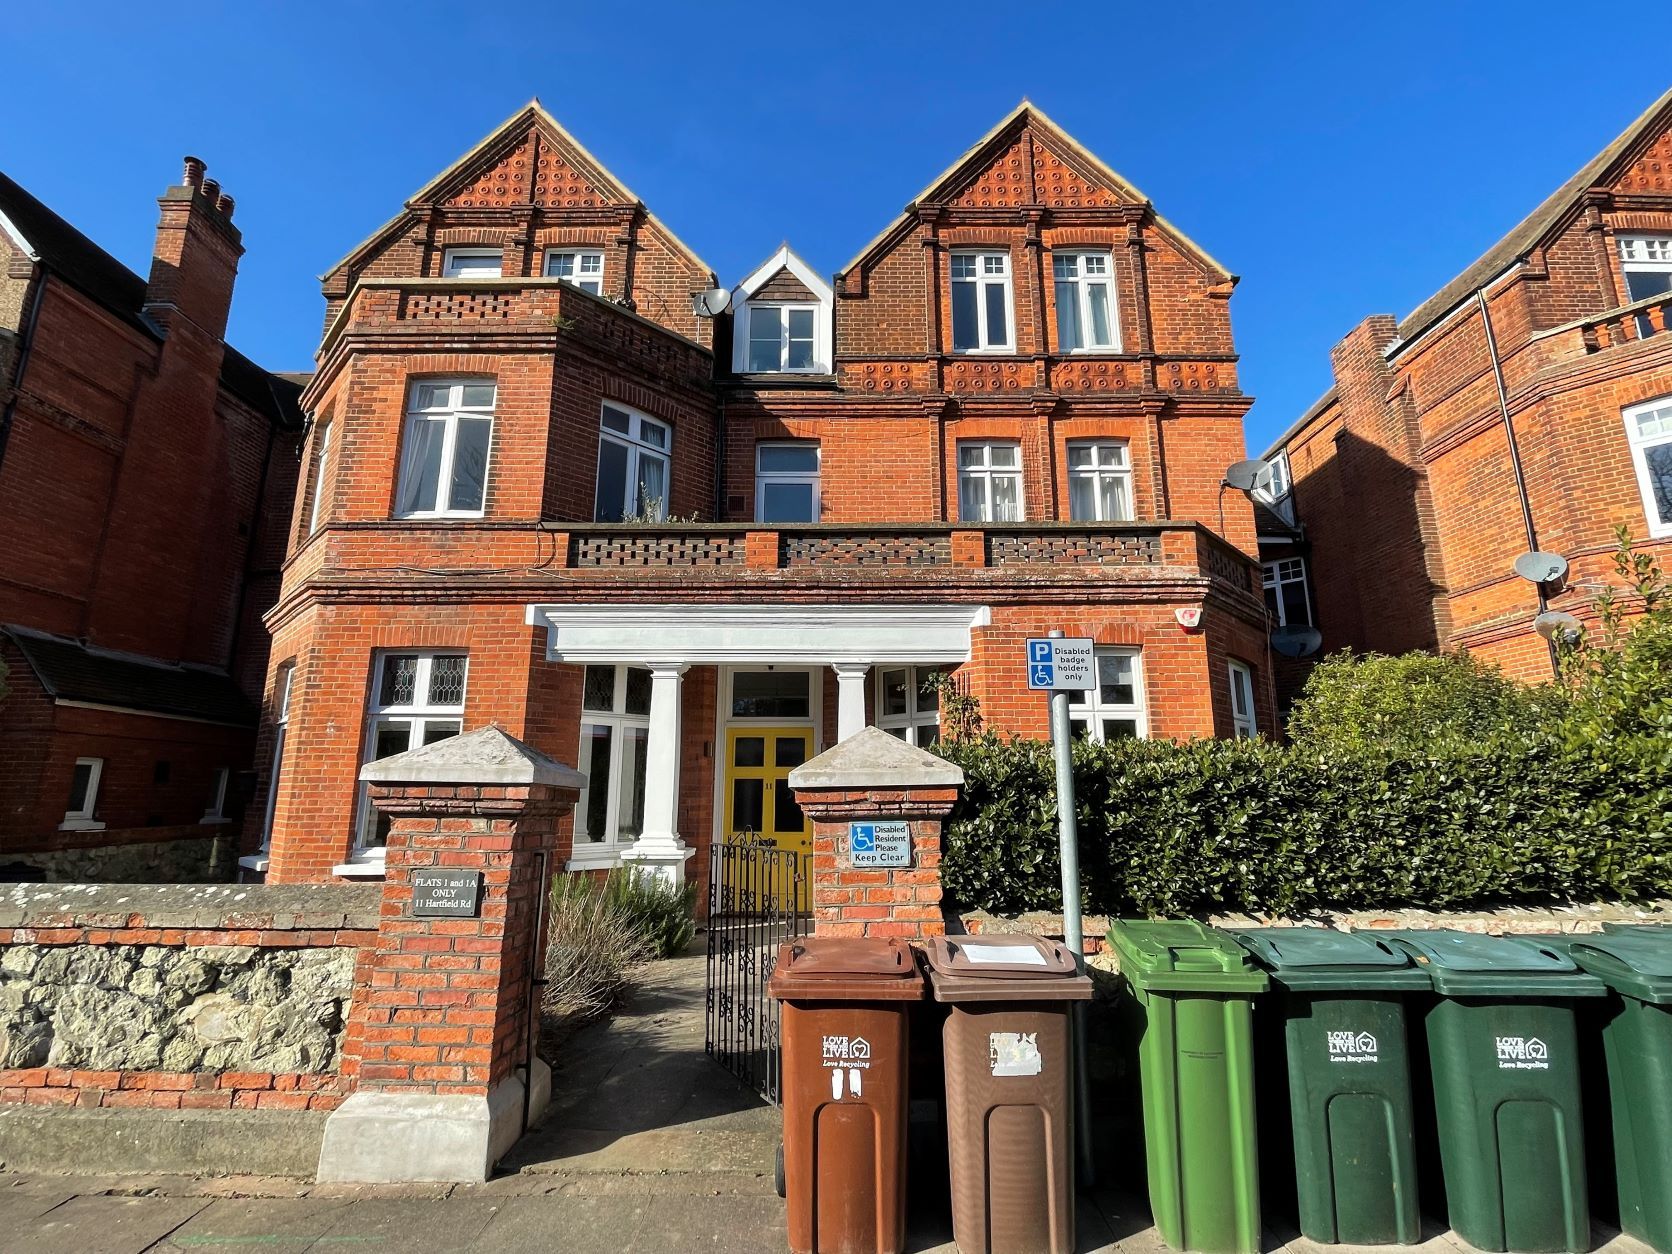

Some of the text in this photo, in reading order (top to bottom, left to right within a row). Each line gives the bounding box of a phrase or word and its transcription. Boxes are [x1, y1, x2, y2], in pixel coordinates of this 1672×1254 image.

[1060, 656, 1086, 664] badge
[1064, 672, 1083, 681] only
[855, 854, 877, 863] Keep
[415, 878, 442, 887] FLATS
[466, 880, 476, 888] 1A
[432, 888, 457, 898] ONLY
[415, 899, 471, 908] 11 Hartfield Rd
[822, 1036, 849, 1044] LOVE
[1327, 1031, 1354, 1040] LOVE
[1496, 1037, 1524, 1046] LOVE
[1328, 1043, 1356, 1053] LIVE
[822, 1048, 849, 1058] LIVE
[1497, 1048, 1526, 1059] LIVE
